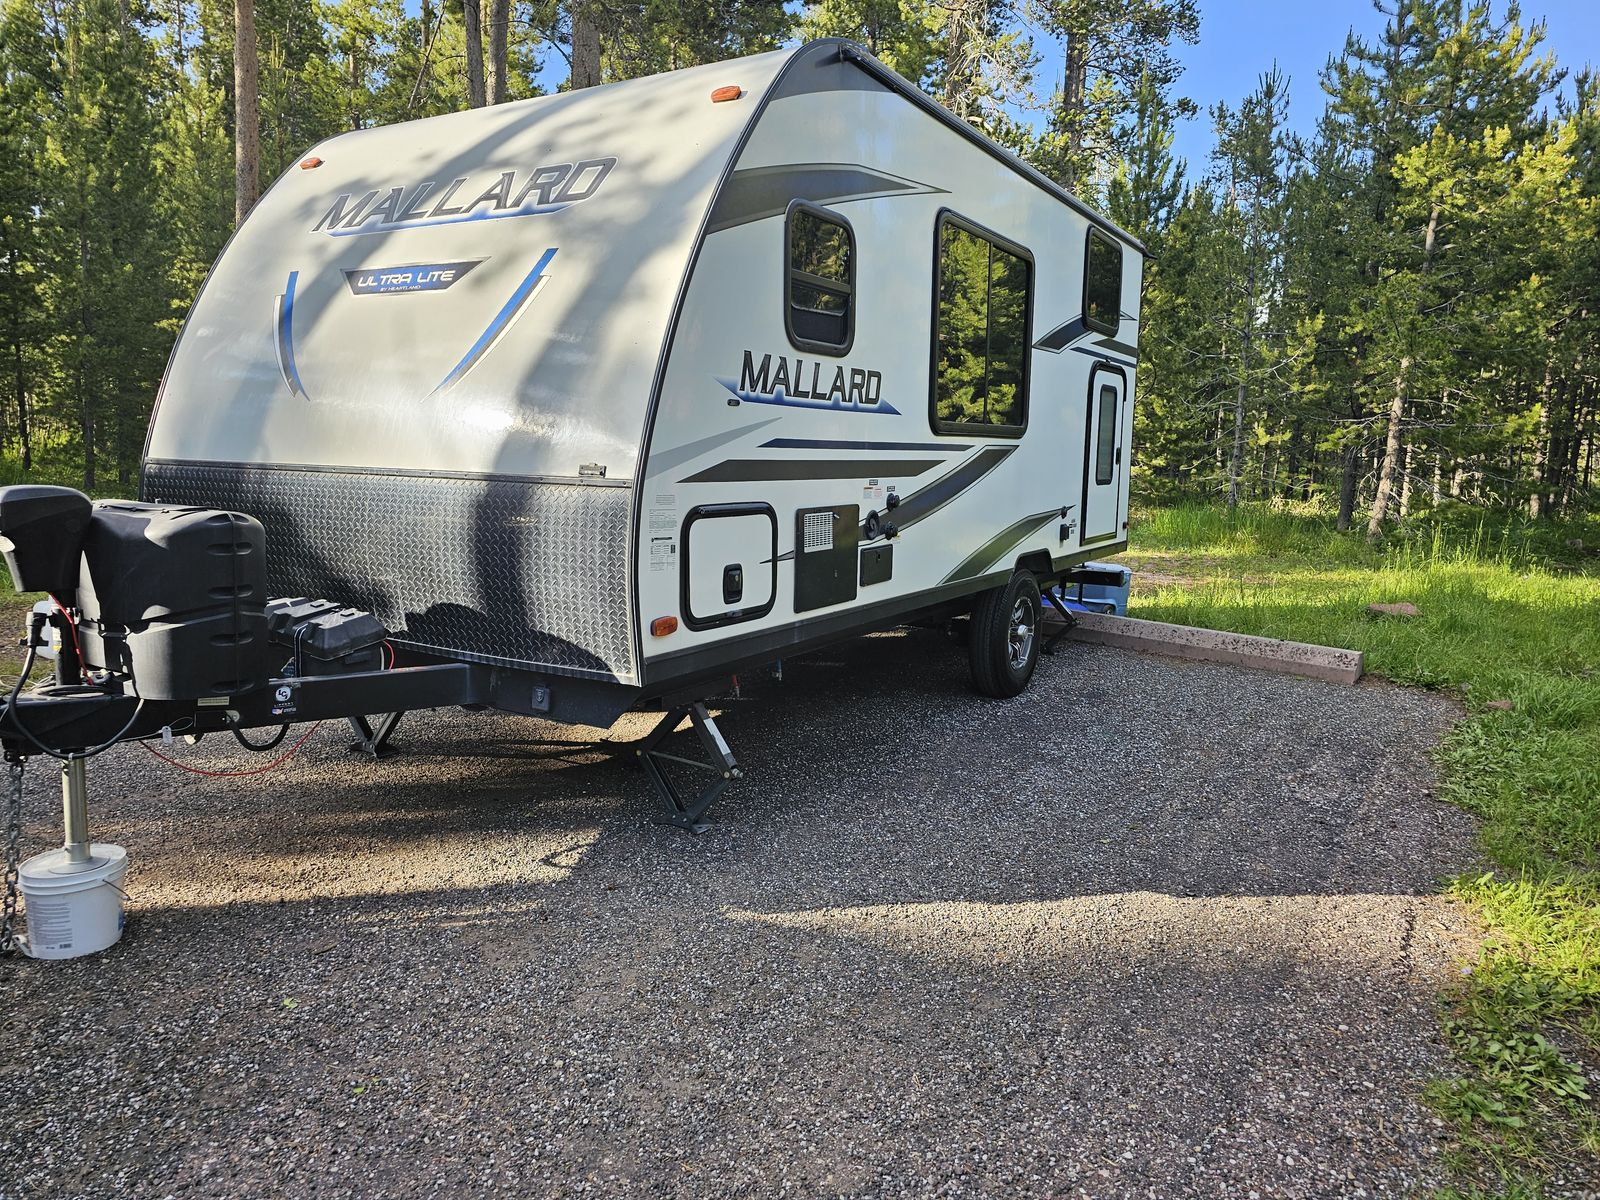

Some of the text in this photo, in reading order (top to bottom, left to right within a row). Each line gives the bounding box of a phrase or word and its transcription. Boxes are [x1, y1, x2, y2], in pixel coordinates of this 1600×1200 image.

[311, 156, 617, 233] MALLARD
[357, 270, 456, 287] ULTRA LITE
[739, 349, 882, 405] MALLARD
